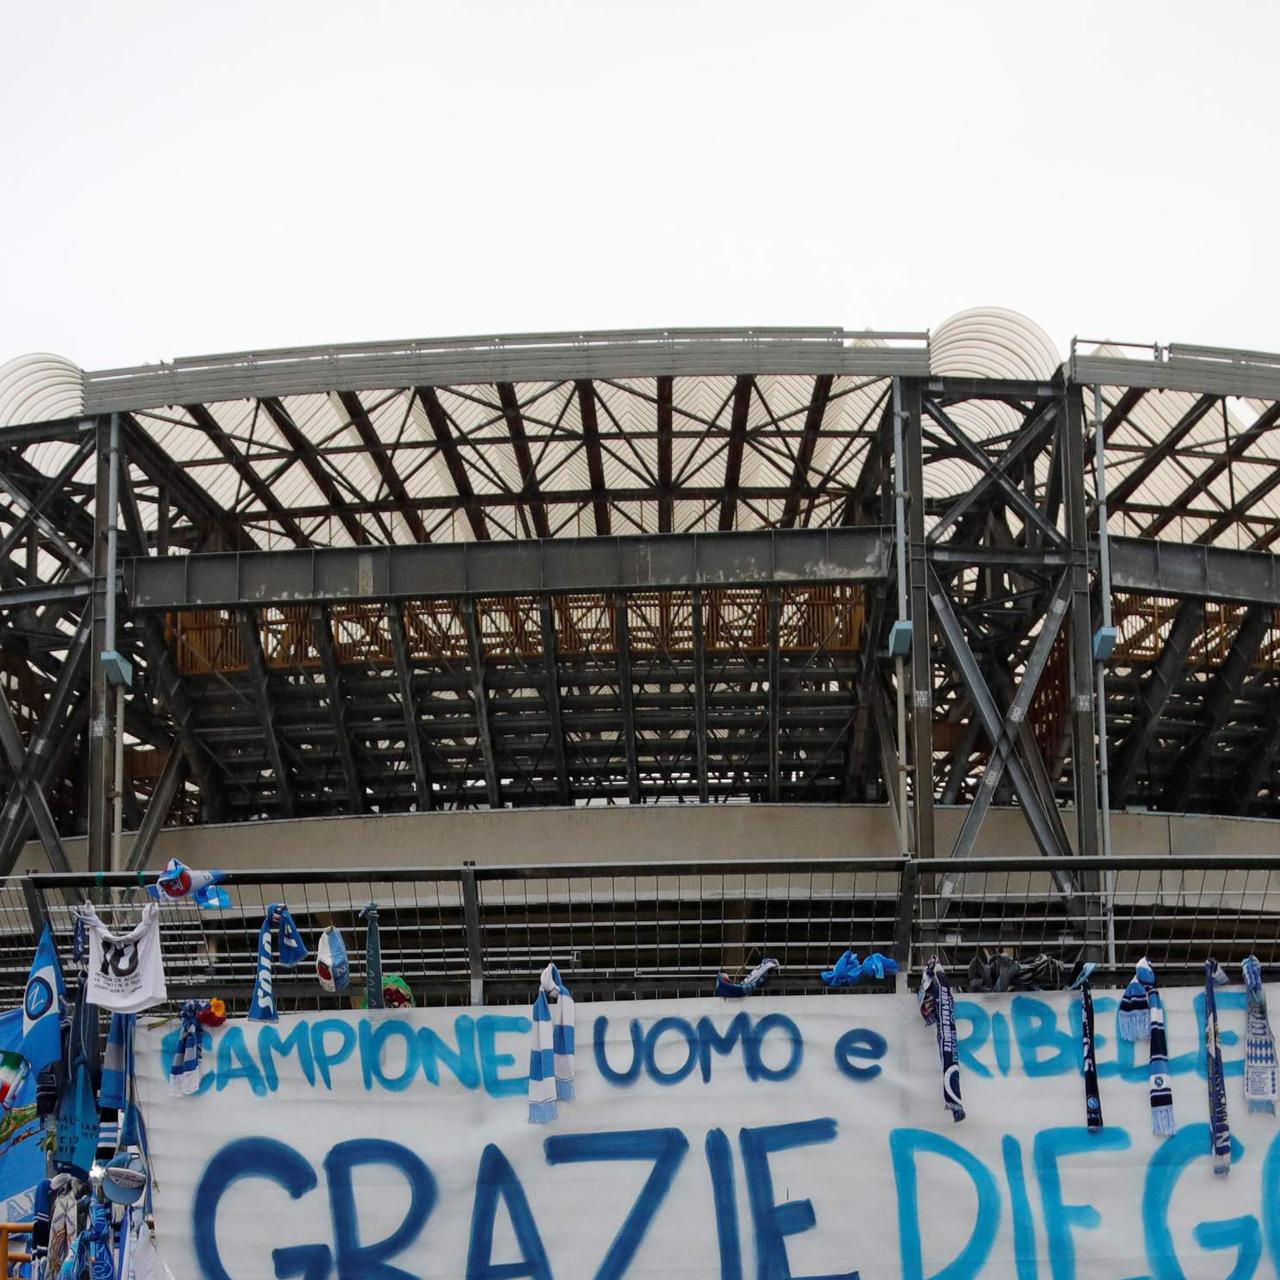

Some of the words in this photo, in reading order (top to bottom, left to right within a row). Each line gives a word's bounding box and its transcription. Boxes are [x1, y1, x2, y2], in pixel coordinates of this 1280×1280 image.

[161, 1013, 533, 1098] CAMPIONE
[593, 1012, 804, 1086] UOMO
[834, 1028, 889, 1081] e
